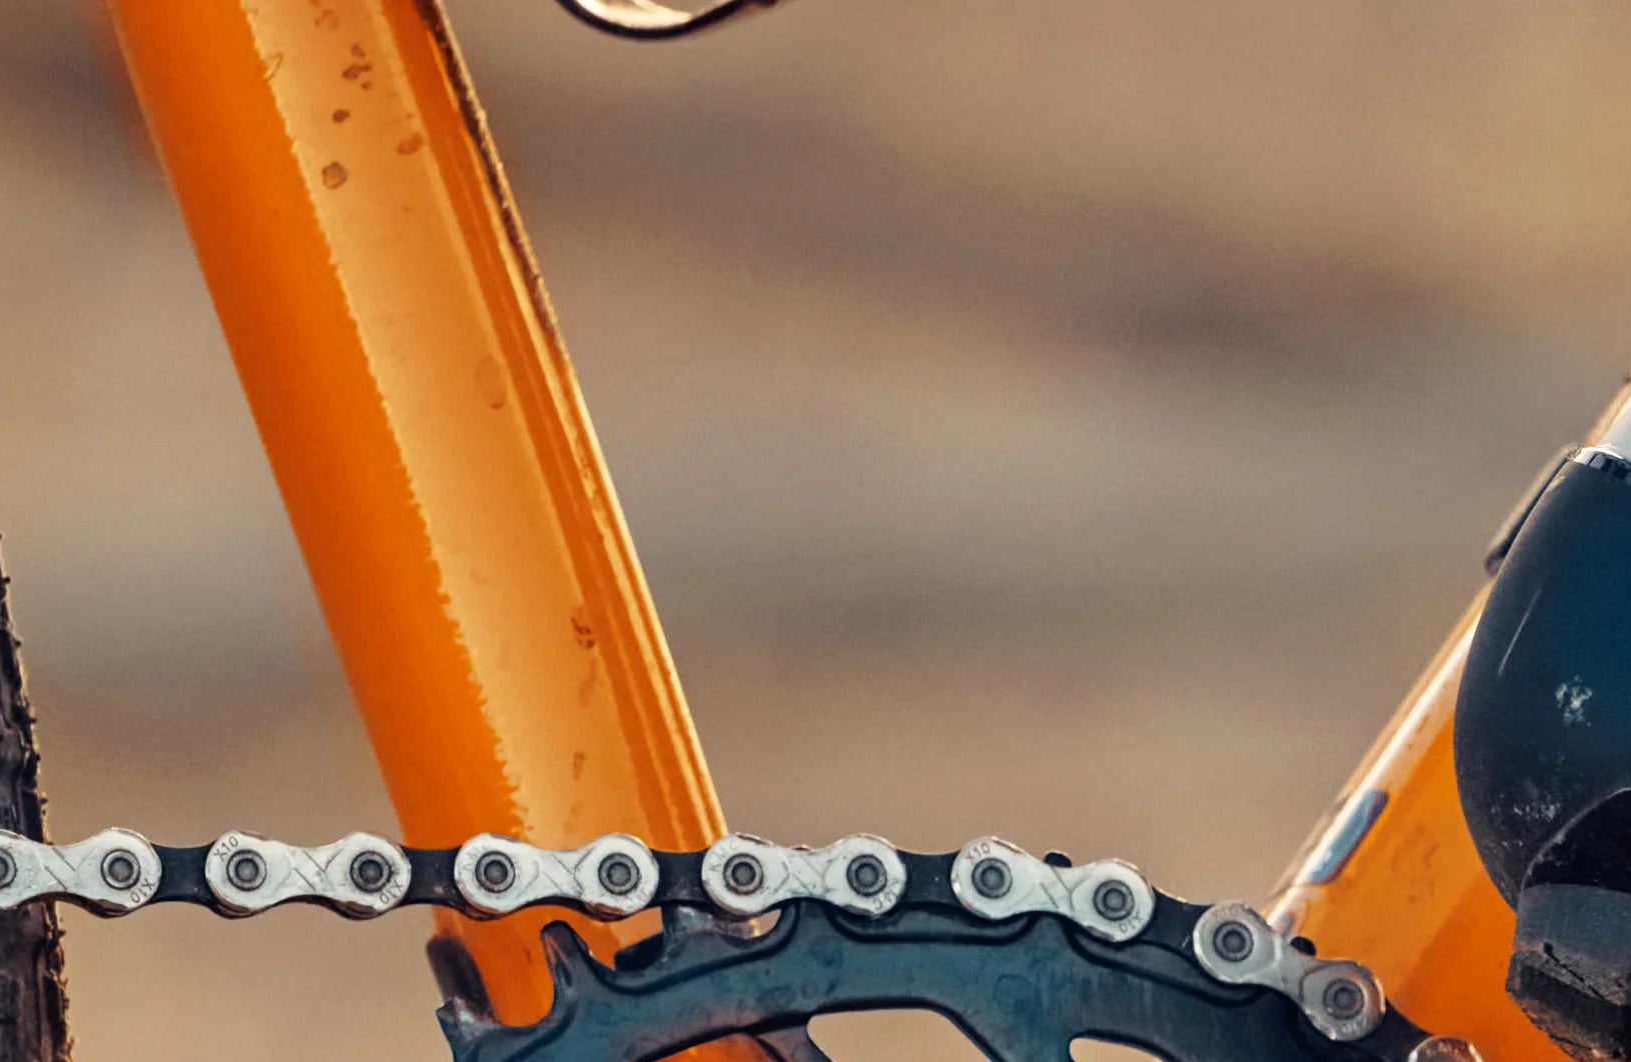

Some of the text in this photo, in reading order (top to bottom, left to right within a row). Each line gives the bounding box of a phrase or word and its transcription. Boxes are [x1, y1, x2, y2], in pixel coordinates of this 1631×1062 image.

[212, 835, 239, 862] X10
[965, 842, 991, 865] X10
[129, 878, 155, 904] X10
[378, 879, 404, 905] X10
